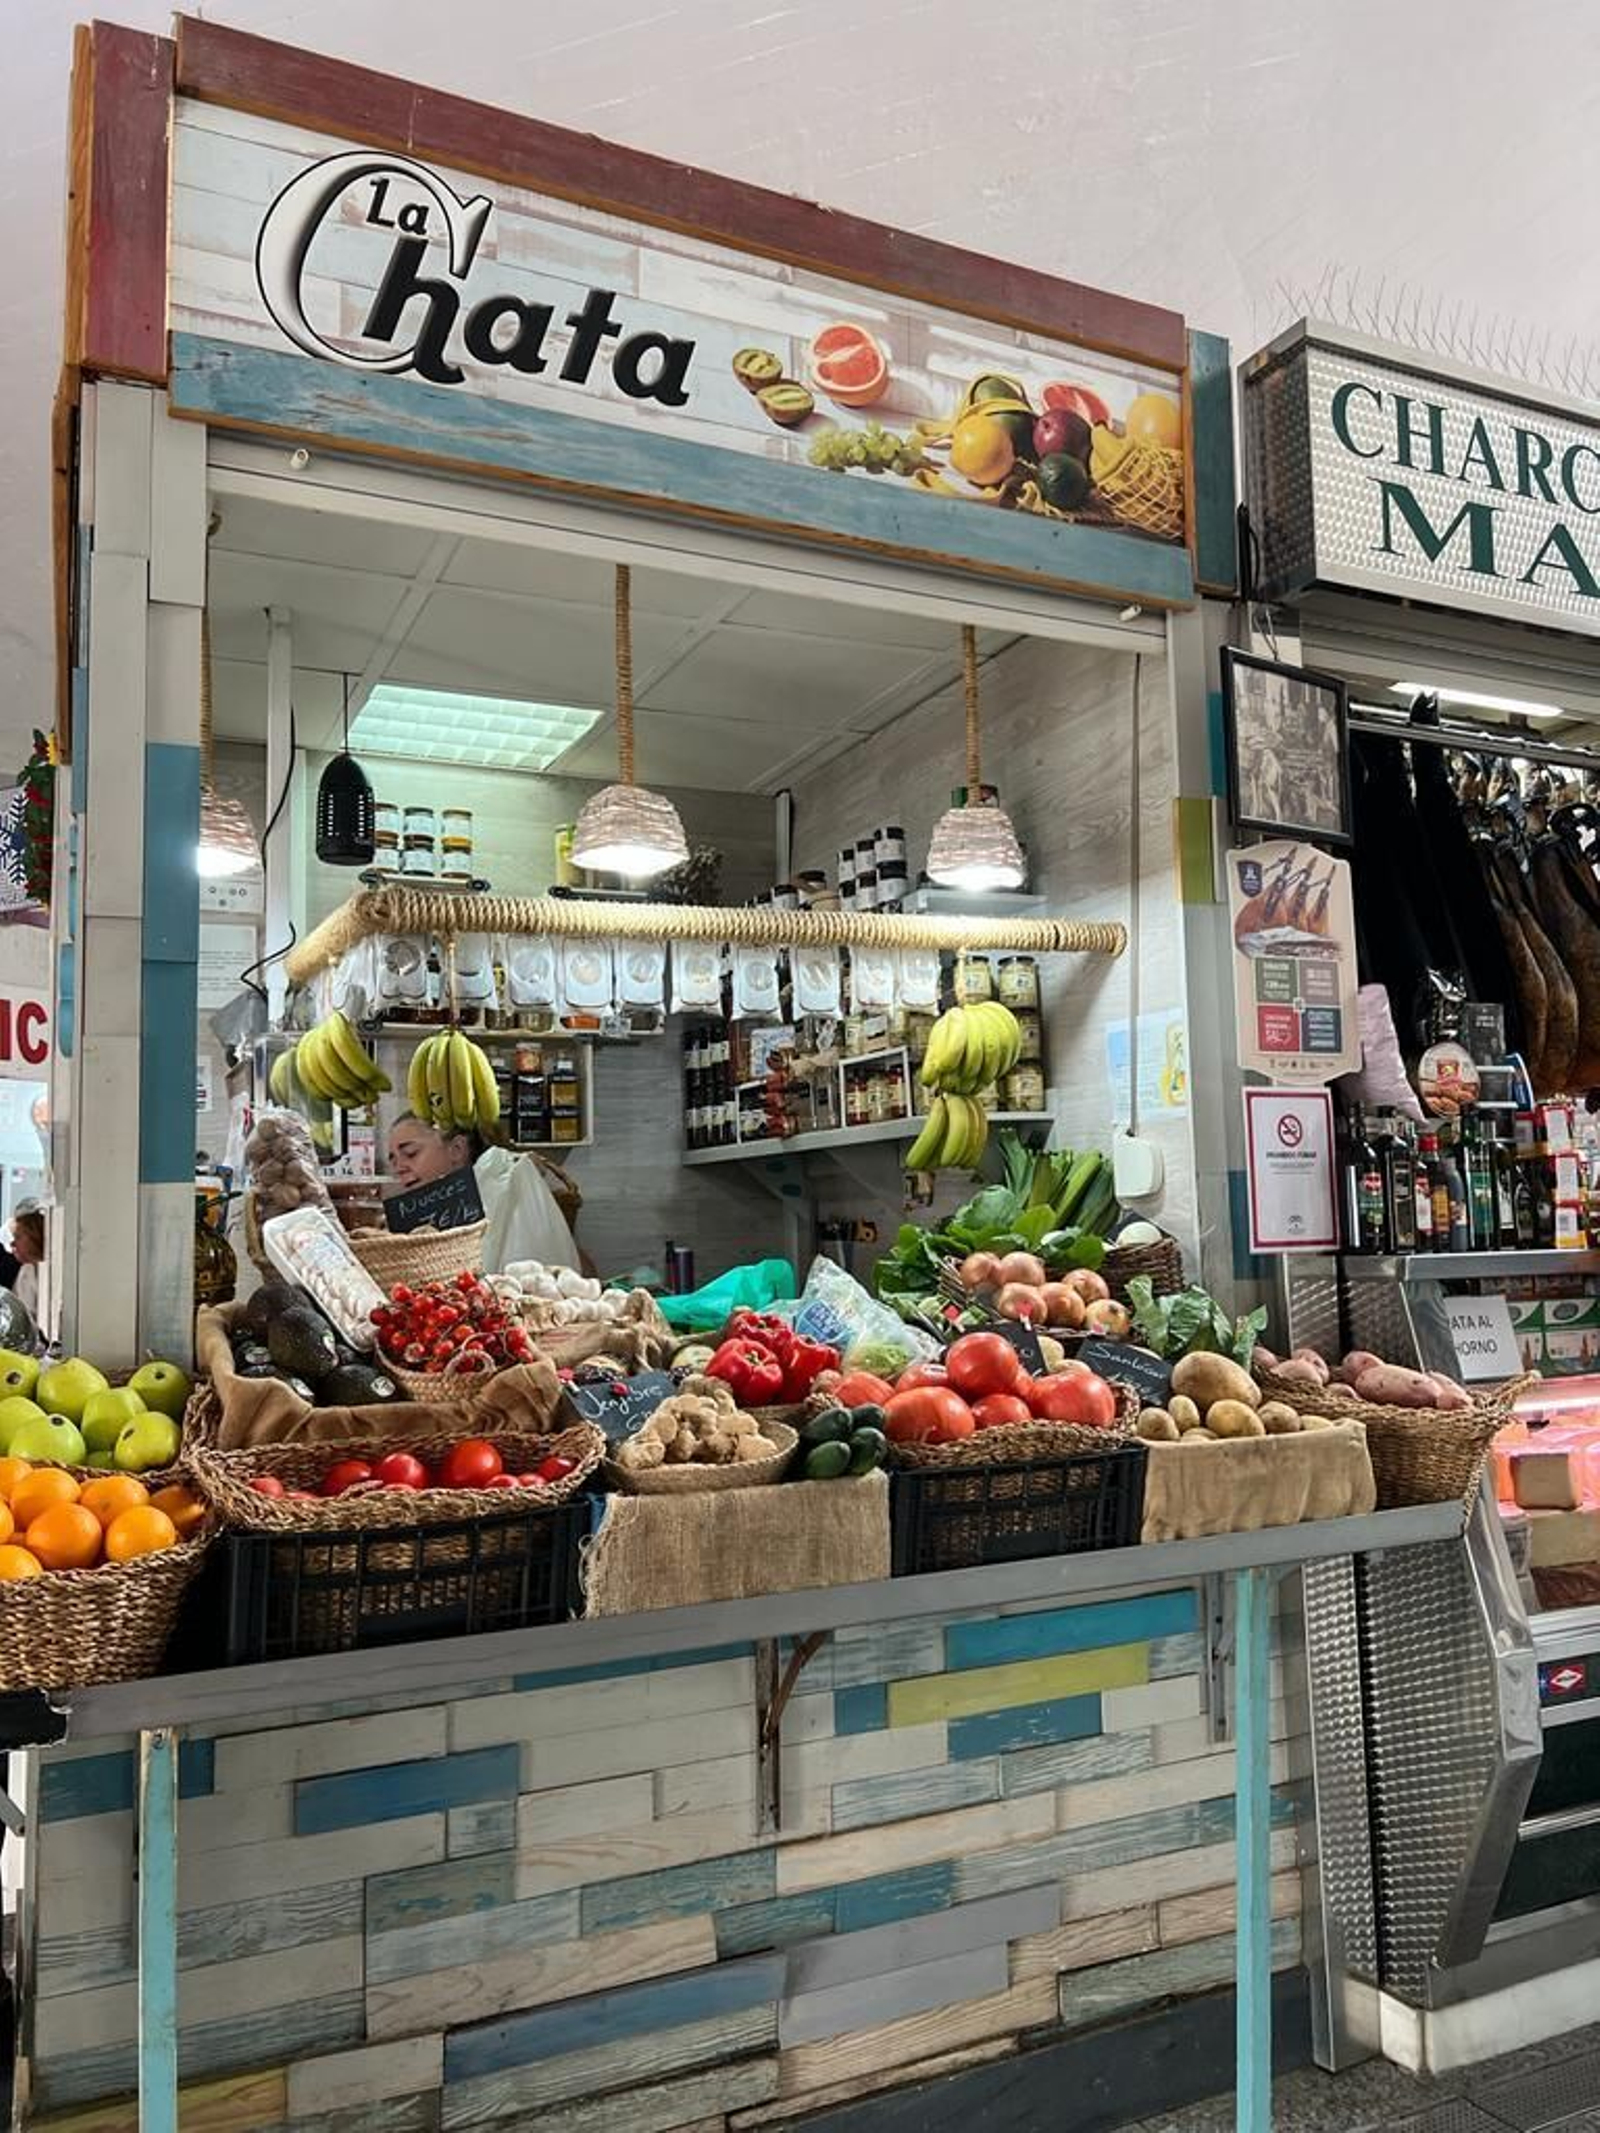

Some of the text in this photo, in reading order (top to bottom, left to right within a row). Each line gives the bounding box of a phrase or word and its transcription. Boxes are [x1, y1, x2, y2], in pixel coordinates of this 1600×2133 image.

[366, 177, 430, 237] La
[255, 151, 698, 406] Chata
[1331, 382, 1600, 515] CHARC
[1366, 475, 1600, 599] MA
